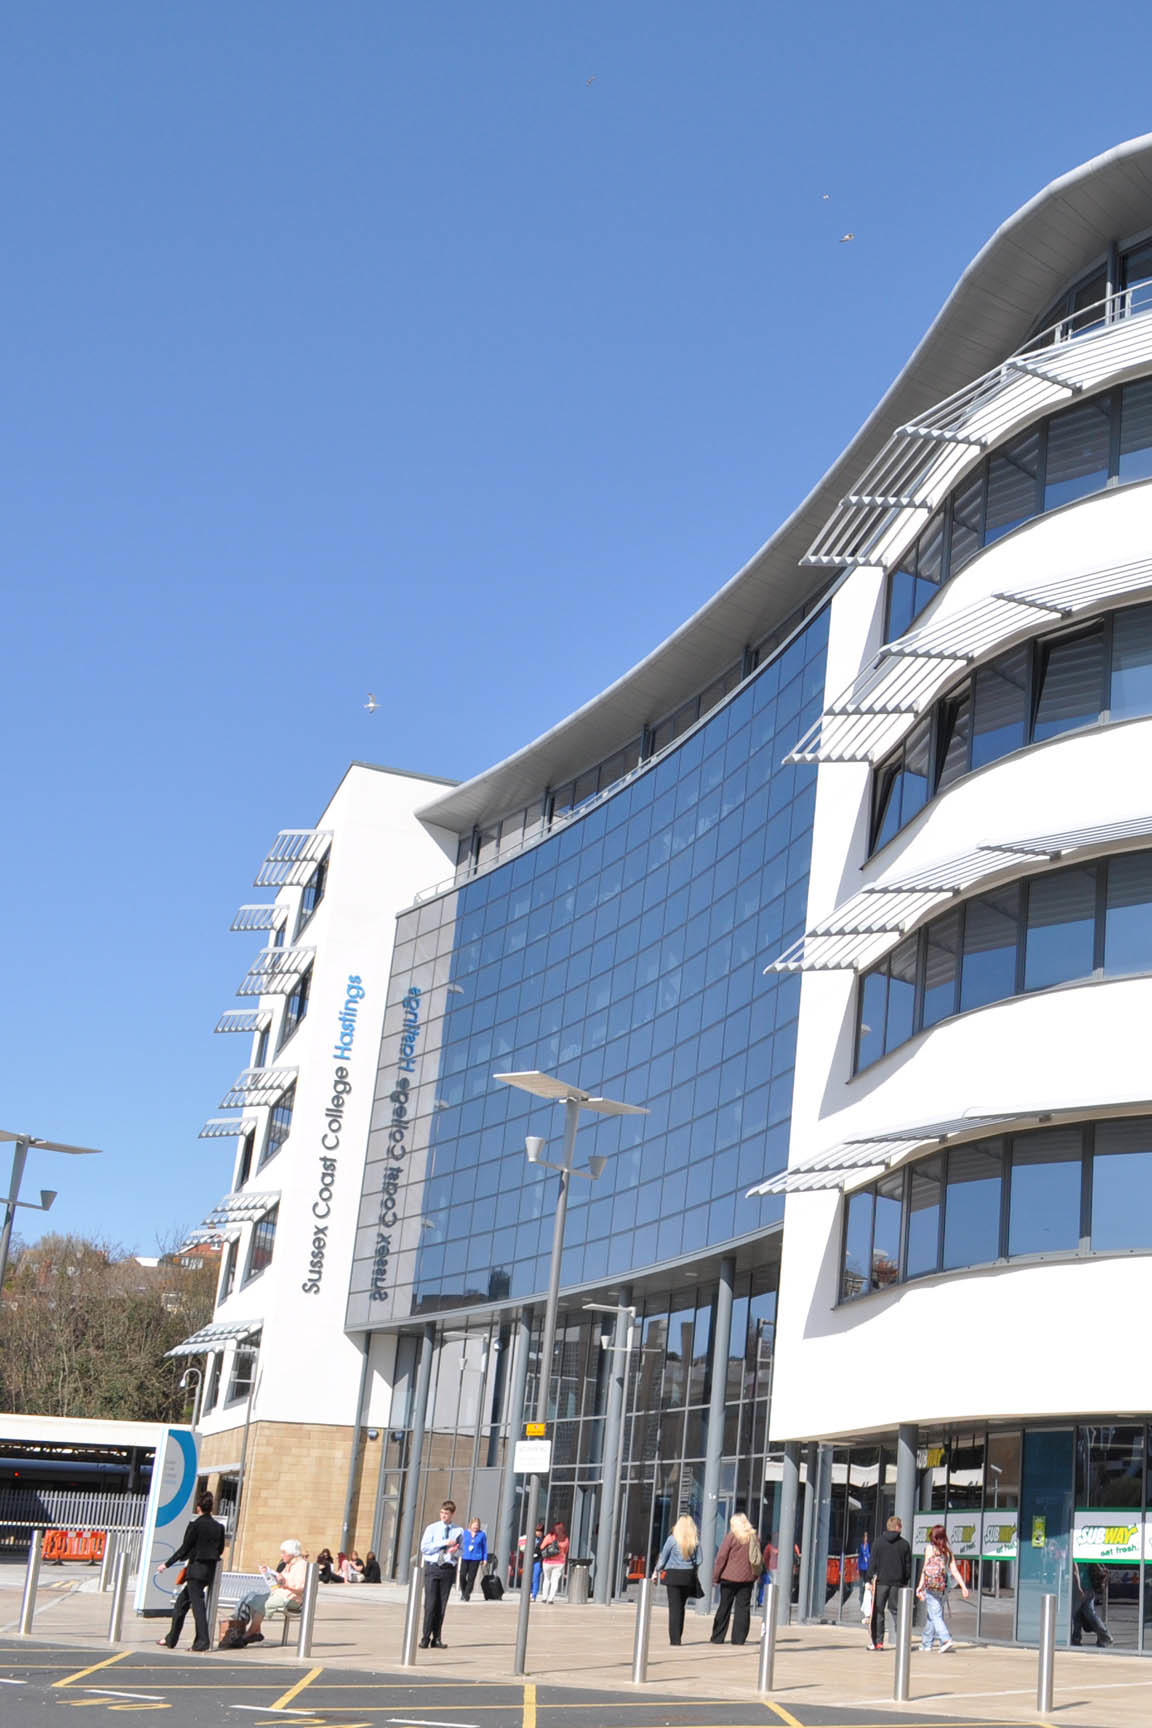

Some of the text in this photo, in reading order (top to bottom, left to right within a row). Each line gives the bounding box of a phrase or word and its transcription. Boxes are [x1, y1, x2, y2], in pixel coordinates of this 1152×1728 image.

[302, 974, 366, 1295] Sussex Coast College Hastings
[1077, 1524, 1139, 1546] SUBWAY
